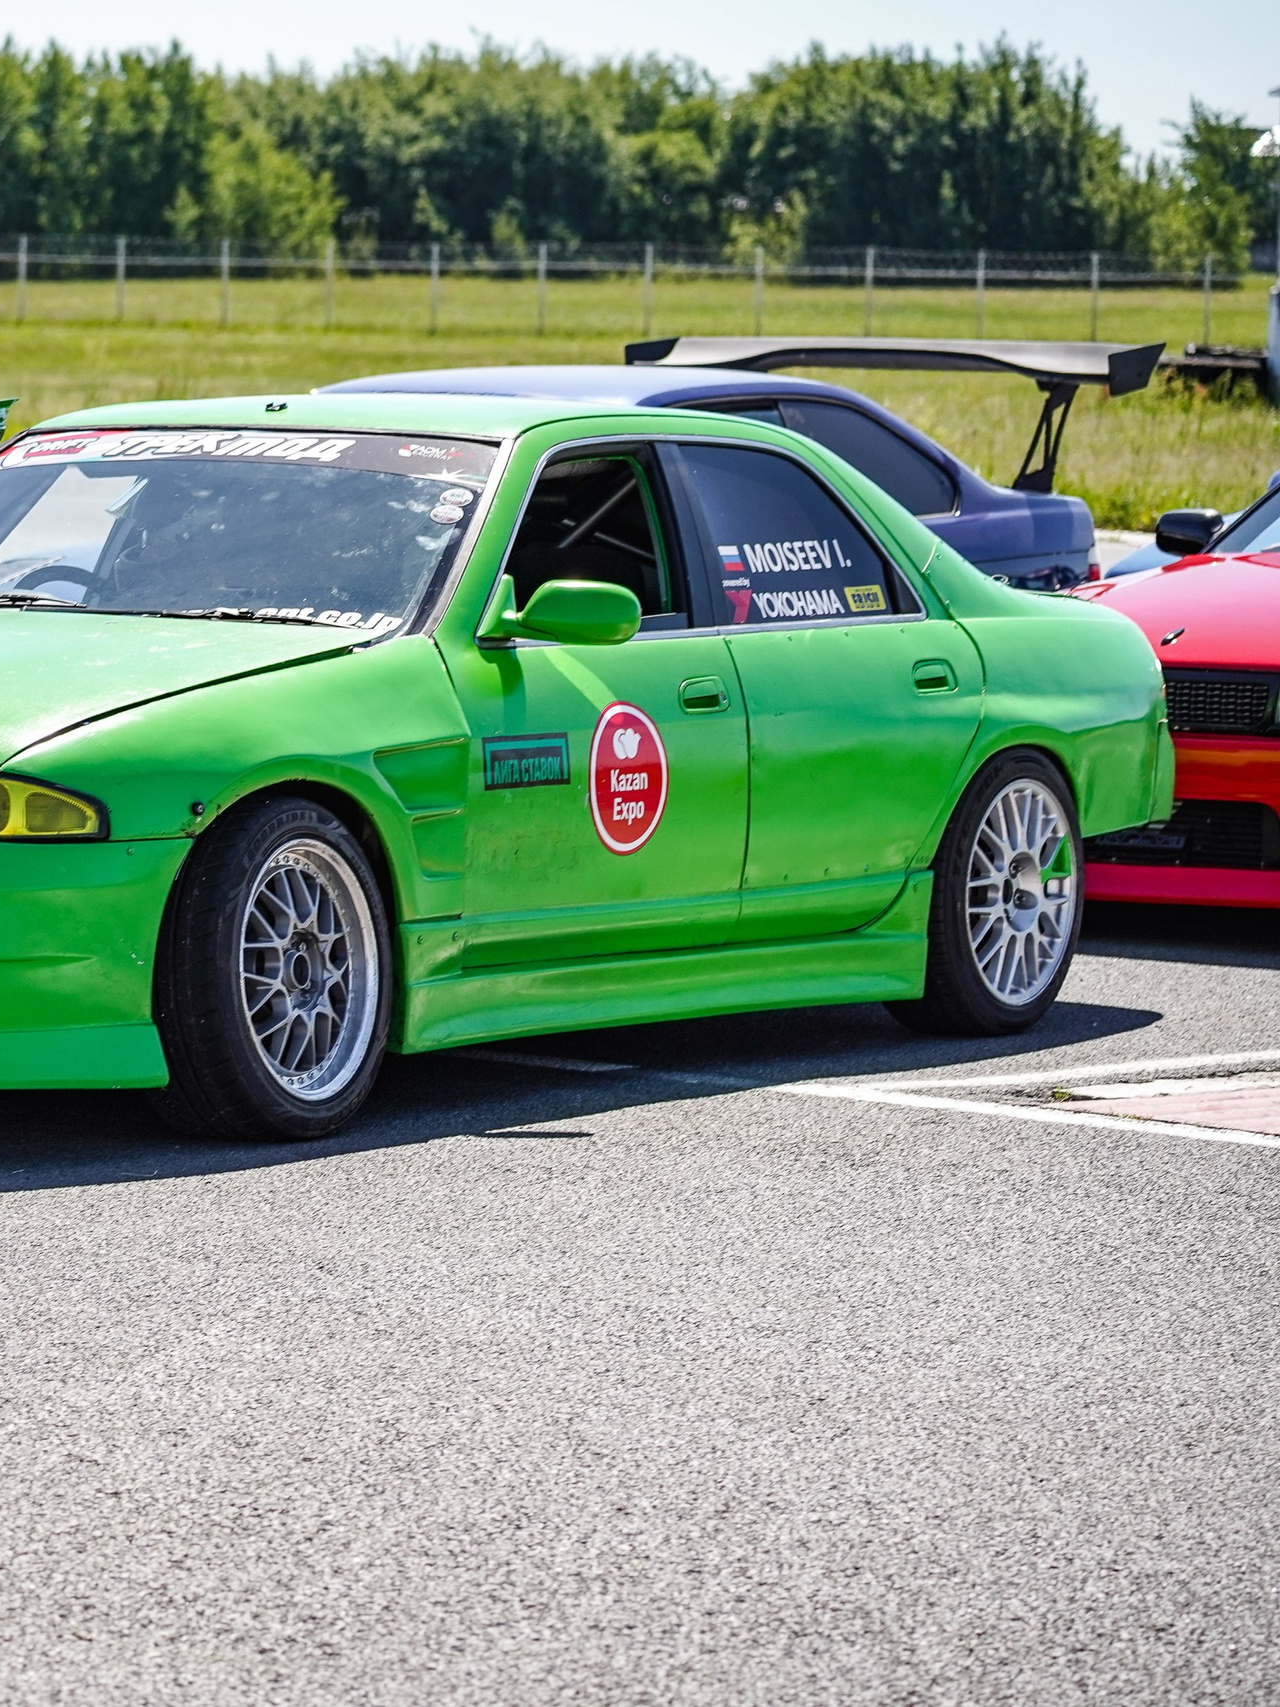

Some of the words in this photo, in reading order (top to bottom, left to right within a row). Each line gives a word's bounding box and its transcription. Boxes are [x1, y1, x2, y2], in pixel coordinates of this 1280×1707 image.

[743, 540, 832, 573] MOISEEV
[752, 589, 845, 619] YOKOHAMA
[493, 758, 521, 785] ЛИГА
[521, 756, 562, 783] СТАВОК
[610, 769, 648, 793] Kazan
[613, 798, 645, 825] Expo
